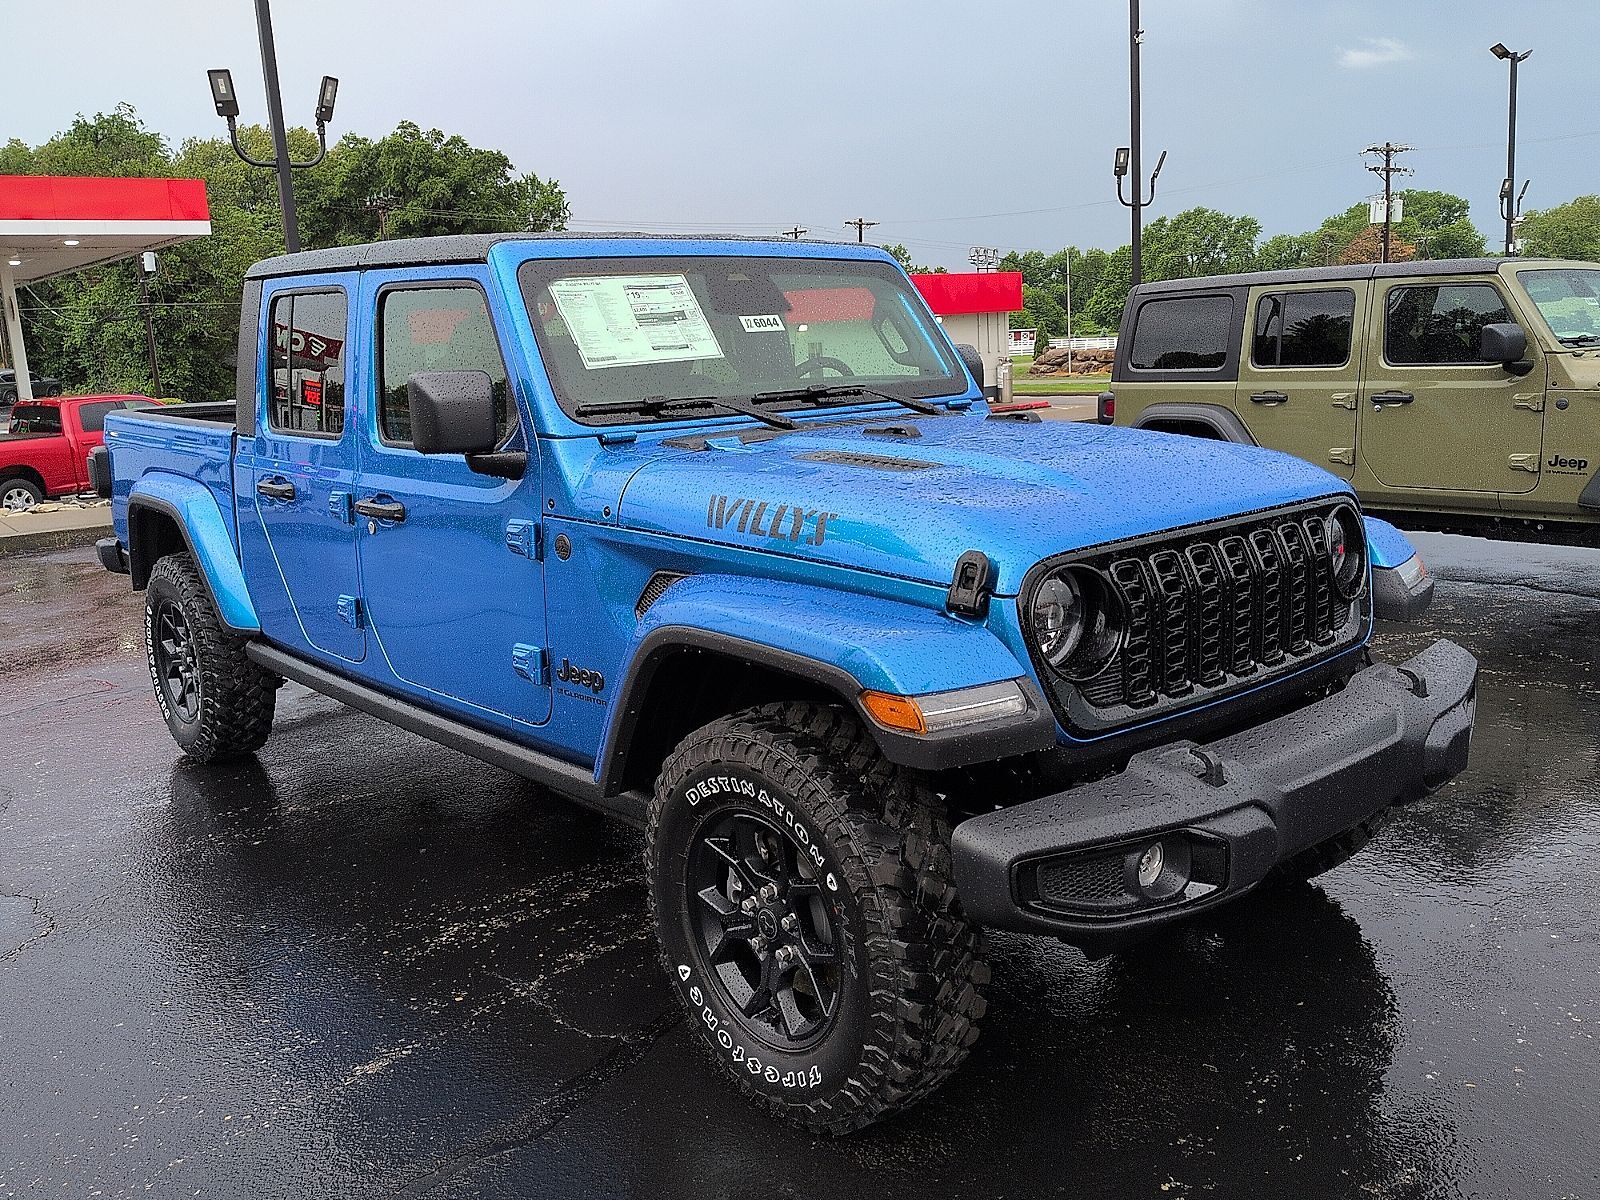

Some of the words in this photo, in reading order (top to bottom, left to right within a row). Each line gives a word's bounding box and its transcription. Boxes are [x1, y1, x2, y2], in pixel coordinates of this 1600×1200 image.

[753, 316, 780, 328] 6044
[1547, 454, 1588, 470] Jeep
[707, 494, 838, 547] WILLYS
[556, 657, 605, 695] Jeep
[685, 776, 826, 868] DESTINATION
